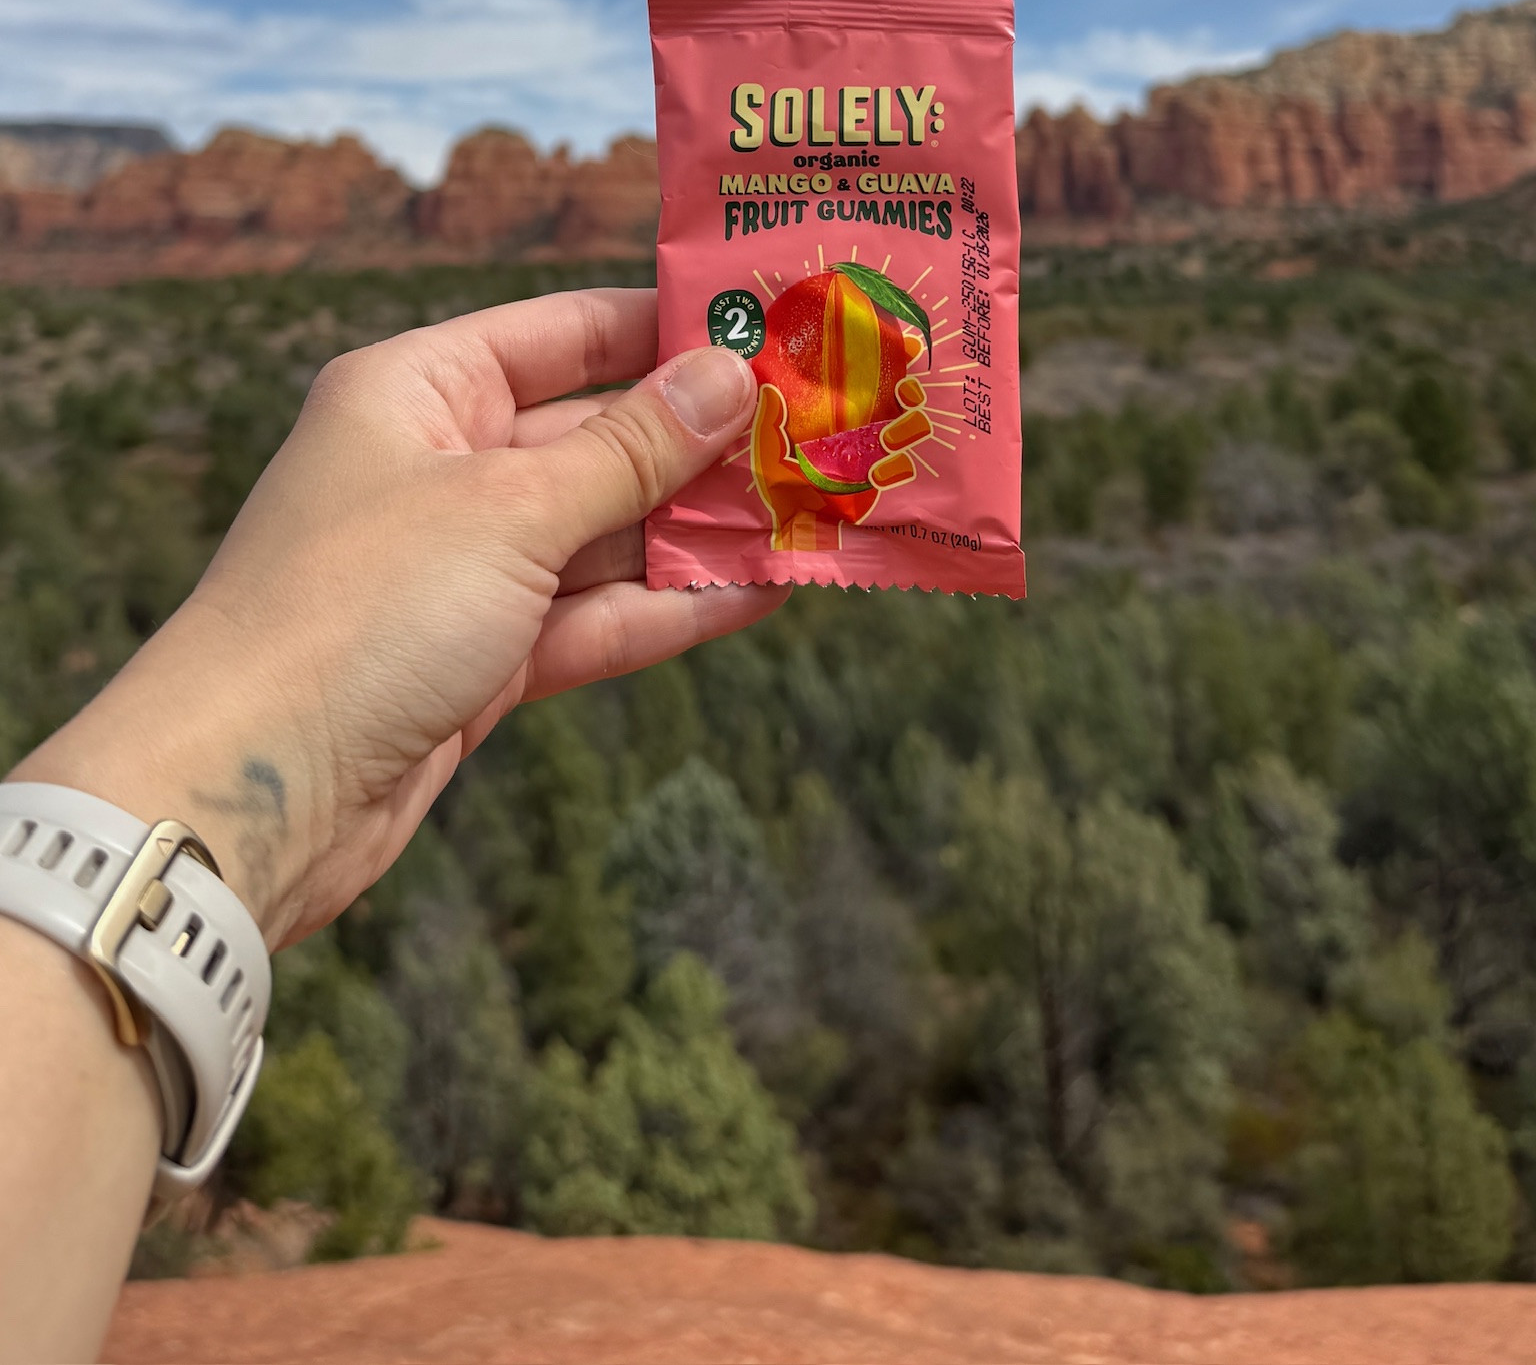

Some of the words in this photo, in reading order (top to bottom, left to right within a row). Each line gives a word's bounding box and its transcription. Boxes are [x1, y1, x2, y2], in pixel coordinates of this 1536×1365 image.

[793, 149, 881, 171] organic
[719, 172, 833, 195] MANGO
[836, 176, 852, 192] &
[856, 172, 957, 196] GUAVA
[960, 176, 976, 215] 00:22
[724, 200, 810, 241] FRUIT
[816, 199, 953, 241] GUMMIES
[713, 296, 731, 316] JUST
[735, 295, 755, 311] TWO
[724, 307, 750, 341] 2
[977, 289, 992, 368] BEFORE:
[713, 328, 762, 356] INDIENTS
[963, 374, 978, 428] LOT:
[977, 376, 992, 435] BEST
[909, 524, 928, 540] 0.7
[931, 531, 948, 546] OZ
[950, 532, 982, 552] (20g)
